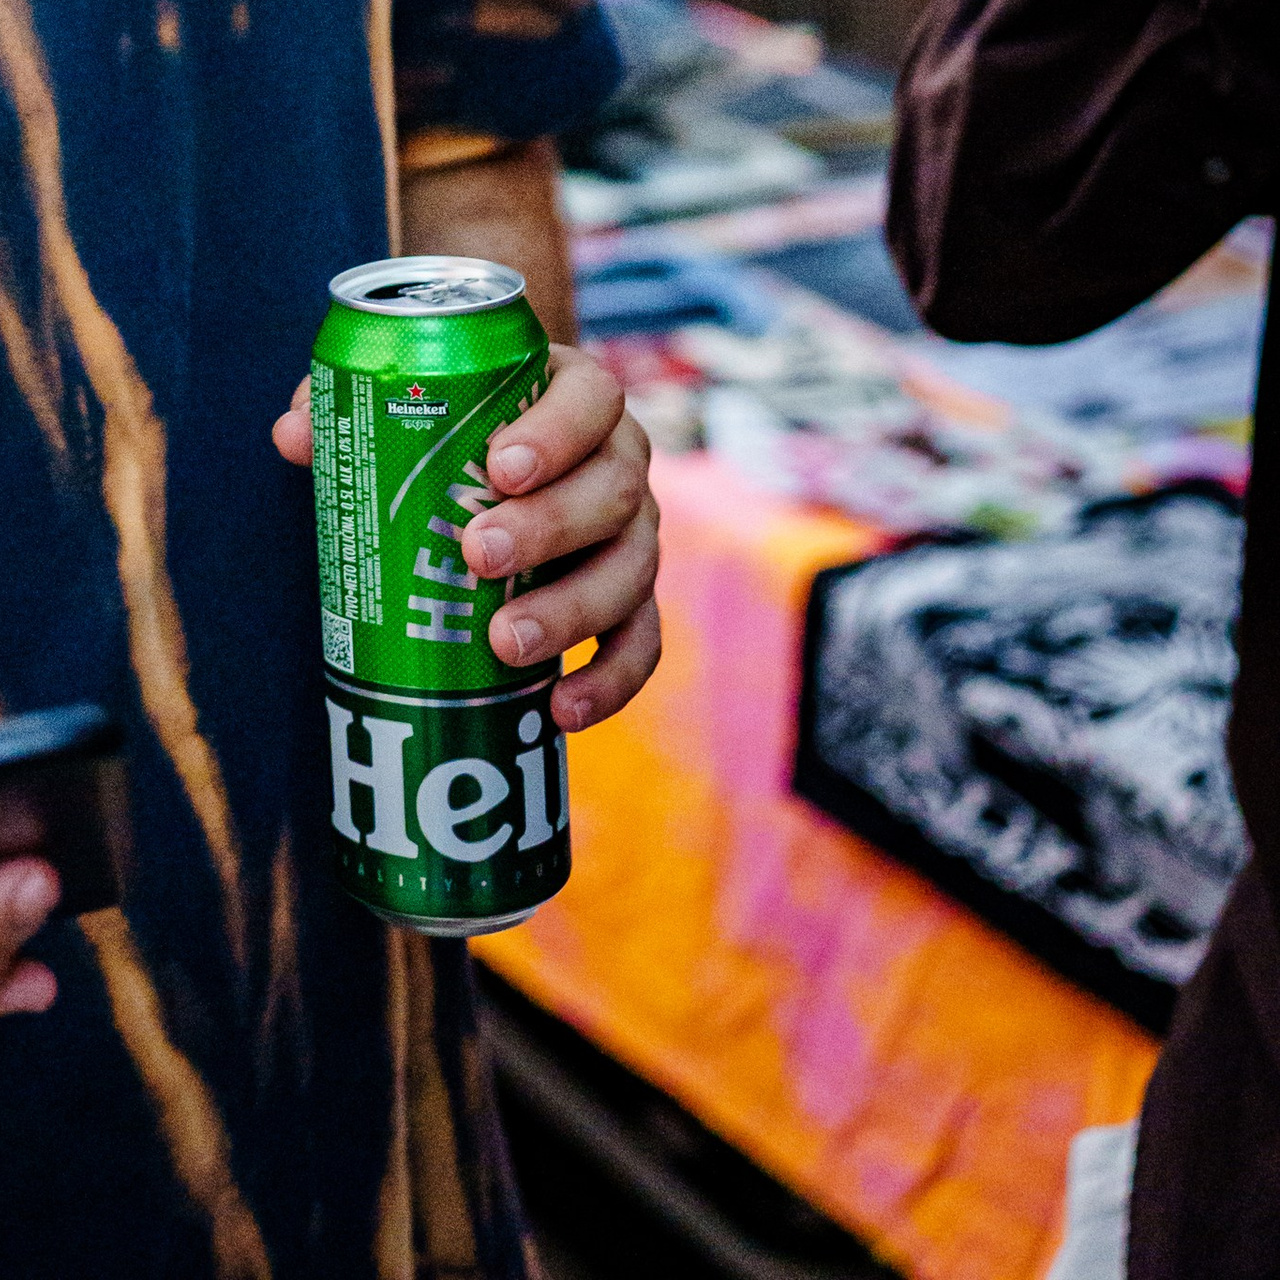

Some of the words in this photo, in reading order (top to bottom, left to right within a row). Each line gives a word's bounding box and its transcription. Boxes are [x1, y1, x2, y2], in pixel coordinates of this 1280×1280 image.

[388, 402, 447, 415] Heineken
[337, 417, 351, 434] VOL
[337, 436, 354, 462] 5,0%
[339, 465, 353, 486] ALK.
